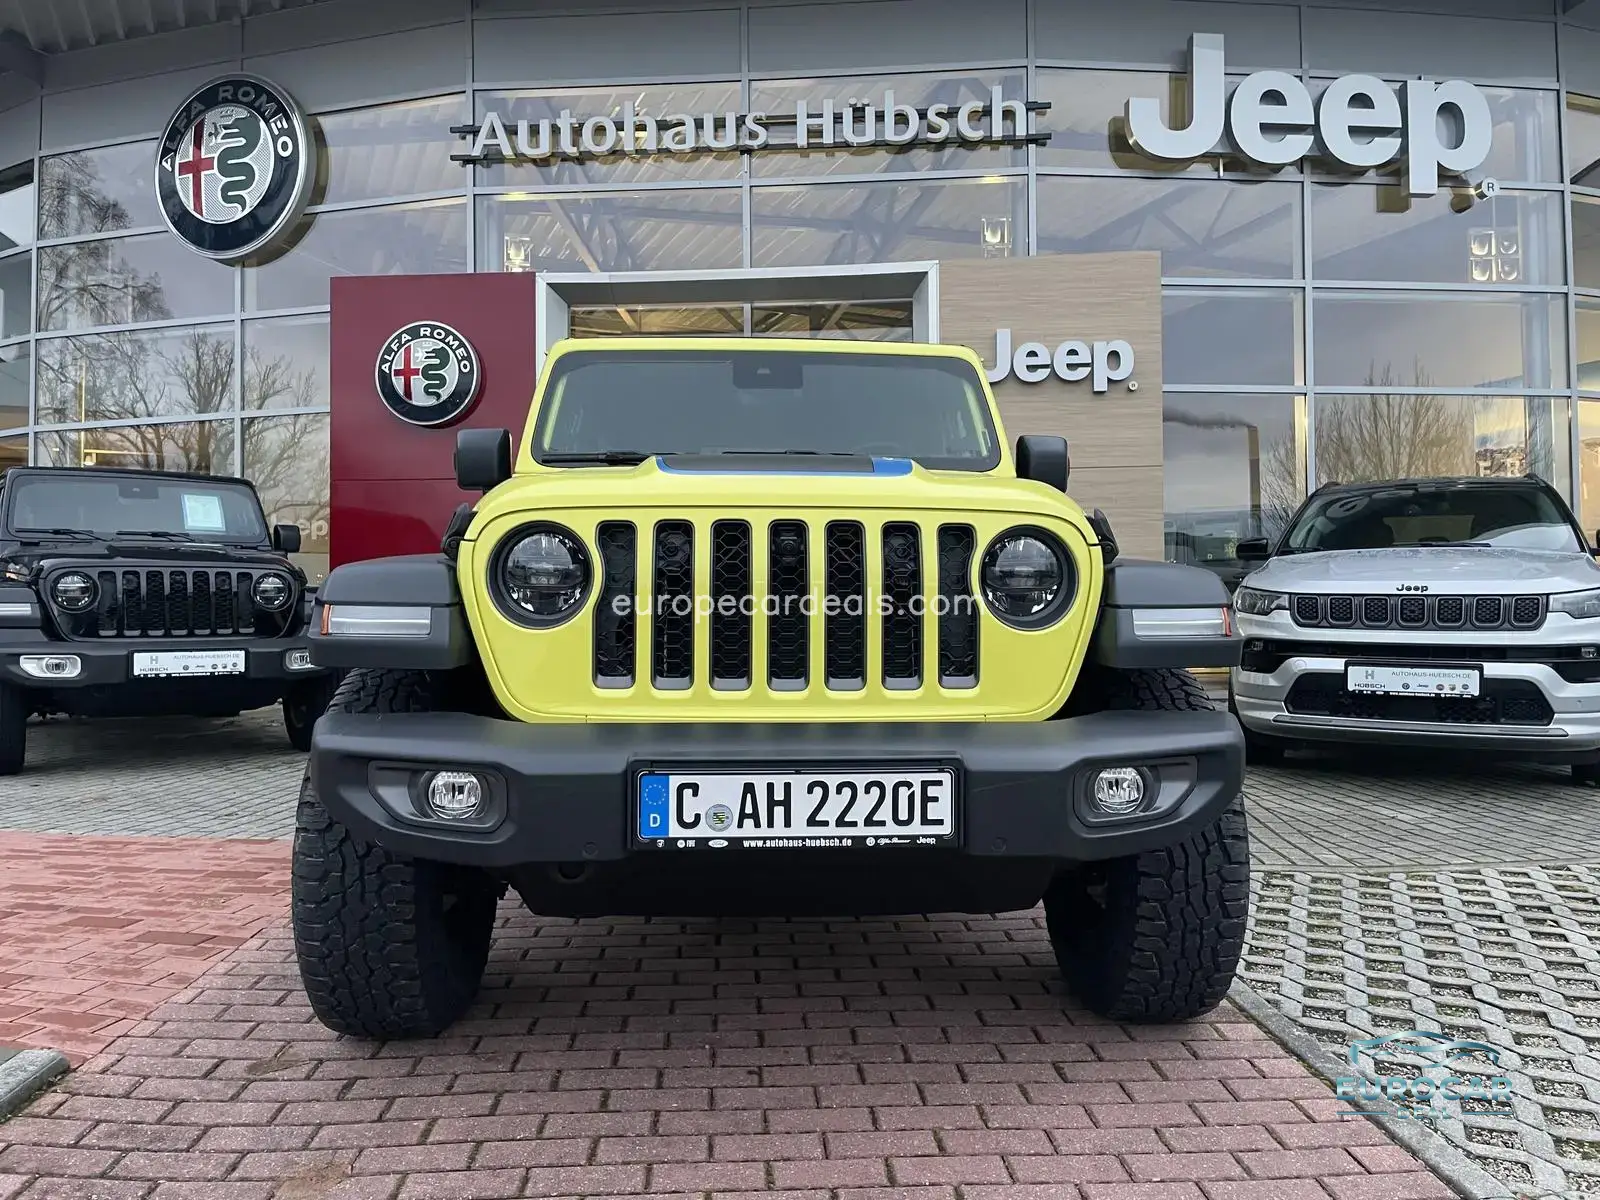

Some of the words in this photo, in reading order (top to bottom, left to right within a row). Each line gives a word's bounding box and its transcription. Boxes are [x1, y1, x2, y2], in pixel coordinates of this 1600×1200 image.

[161, 100, 206, 172] ALFA
[217, 85, 293, 158] ROMEO
[471, 101, 767, 158] Autohaus
[797, 86, 1028, 148] Hübsch
[1125, 32, 1492, 198] Jeep
[381, 332, 412, 374] ALFA
[420, 327, 471, 373] ROMEO
[985, 328, 1135, 393] Jeep
[1396, 584, 1428, 593] Jeep
[649, 813, 660, 827] D
[676, 782, 701, 829] C
[737, 781, 792, 829] AH
[806, 779, 944, 827] 2220E
[743, 837, 852, 848] www.autohaus-huebsch.de
